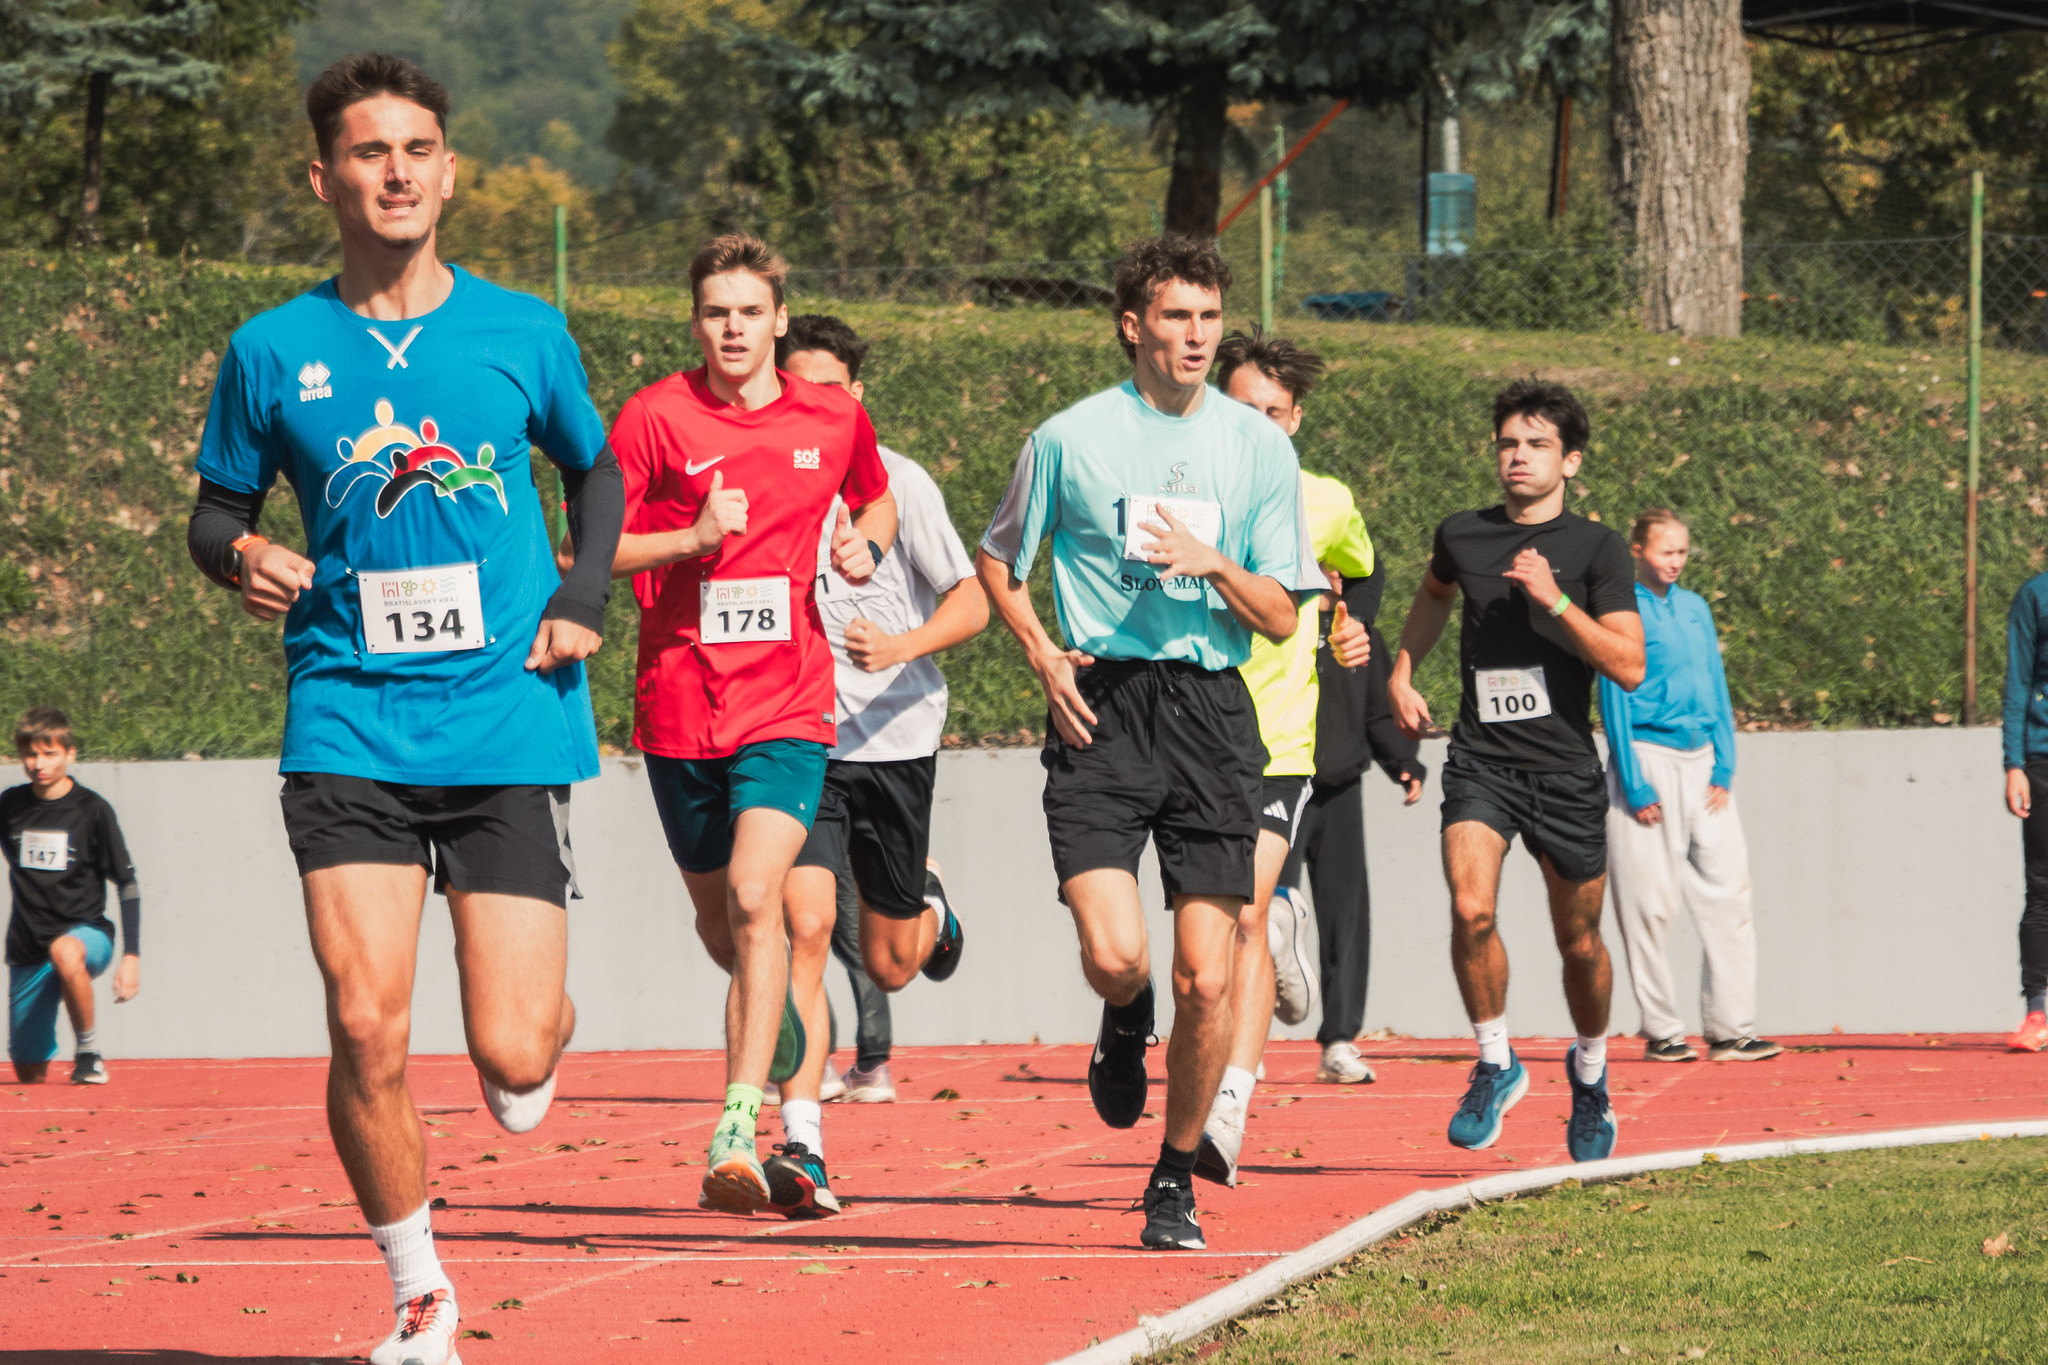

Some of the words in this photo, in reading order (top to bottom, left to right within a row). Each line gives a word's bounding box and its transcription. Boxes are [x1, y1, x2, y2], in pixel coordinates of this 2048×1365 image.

[793, 446, 820, 464] SOŠ
[385, 608, 465, 643] 134
[717, 608, 776, 634] 178
[1490, 693, 1537, 716] 100
[28, 850, 57, 866] 147
